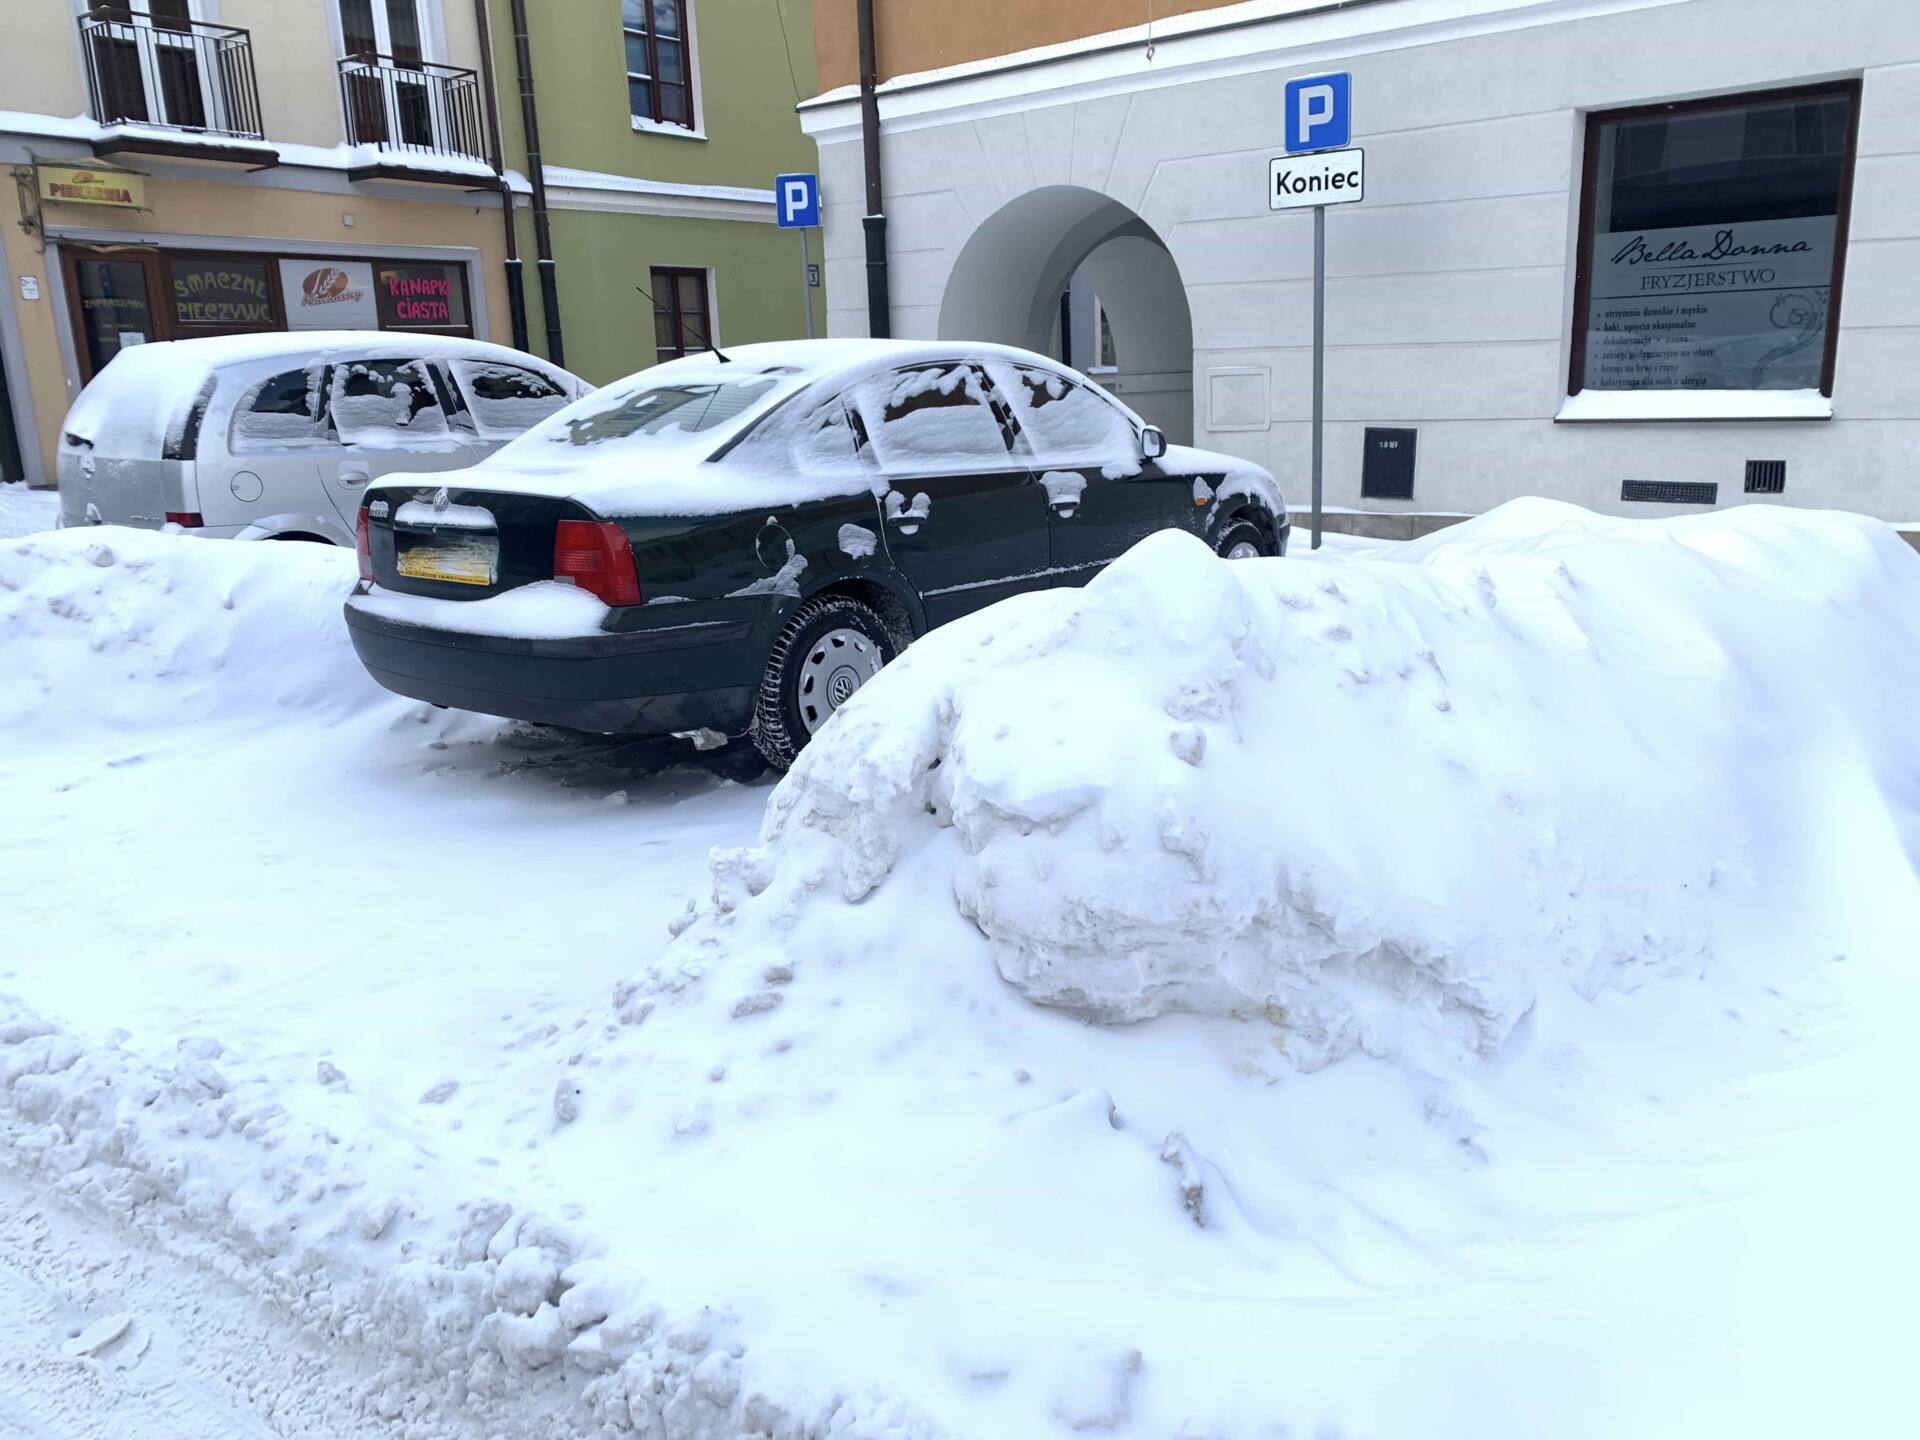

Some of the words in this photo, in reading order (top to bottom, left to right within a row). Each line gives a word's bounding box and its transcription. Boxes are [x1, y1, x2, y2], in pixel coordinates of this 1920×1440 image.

[1299, 84, 1334, 143] P
[1276, 166, 1359, 196] Koniec
[785, 181, 809, 222] P
[1611, 235, 1699, 265] Bella
[1701, 229, 1813, 261] Donna
[389, 277, 453, 297] KANAPKI
[1640, 268, 1776, 290] FRYZJERSTWO
[1642, 305, 1674, 317] damskie
[1680, 303, 1708, 317] męskie
[1652, 319, 1696, 332] okazjonalne
